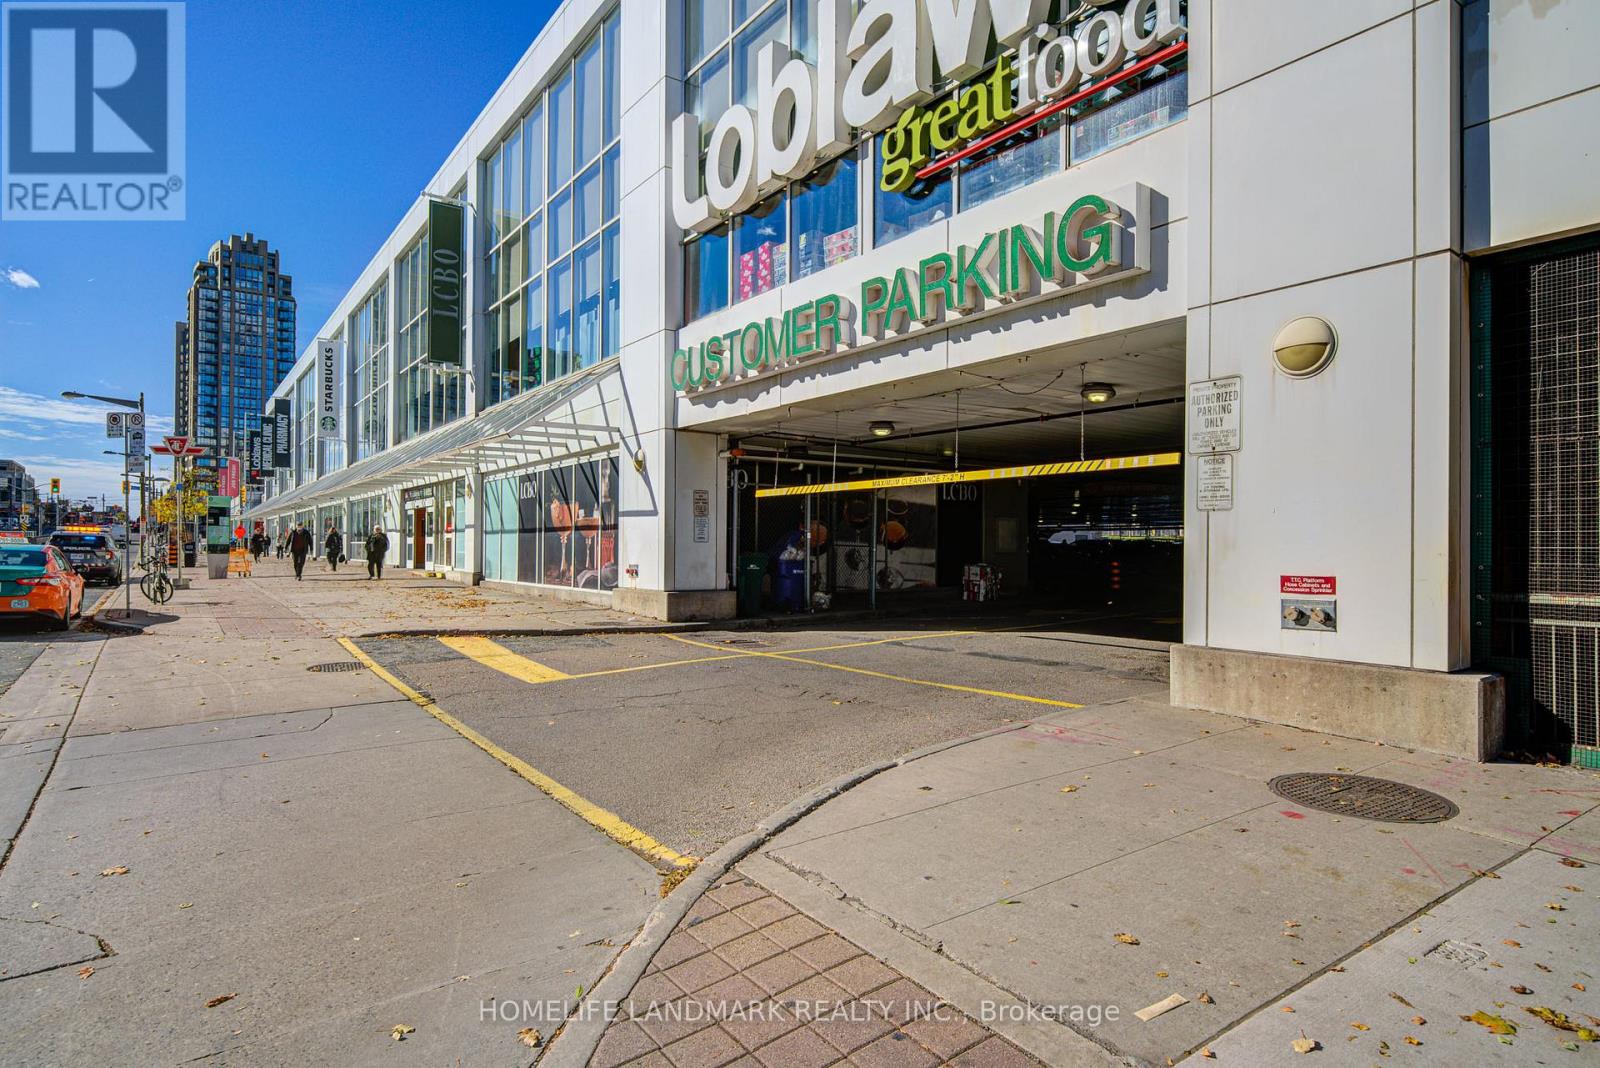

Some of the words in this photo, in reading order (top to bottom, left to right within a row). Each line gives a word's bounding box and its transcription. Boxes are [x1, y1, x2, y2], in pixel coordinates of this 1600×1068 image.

[880, 54, 1019, 192] great
[1012, 0, 1180, 113] food
[671, 0, 1115, 230] Lobla
[432, 248, 460, 320] LCBO
[670, 293, 841, 392] CUSTOMER
[861, 194, 1113, 336] PARKING
[324, 347, 333, 412] STARBUCKS
[1190, 390, 1239, 406] AUTHORIZED
[1197, 403, 1232, 417] PARKING
[262, 423, 273, 443] CLINIC
[276, 412, 288, 454] PHARMACY
[1204, 416, 1224, 429] ONLY
[251, 436, 261, 470] Loblaws
[262, 443, 273, 470] MEDICAL
[520, 480, 537, 499] LCBO
[872, 479, 899, 488] MAXIMUM
[901, 475, 941, 486] CLEARANCE
[943, 483, 977, 501] LCBO
